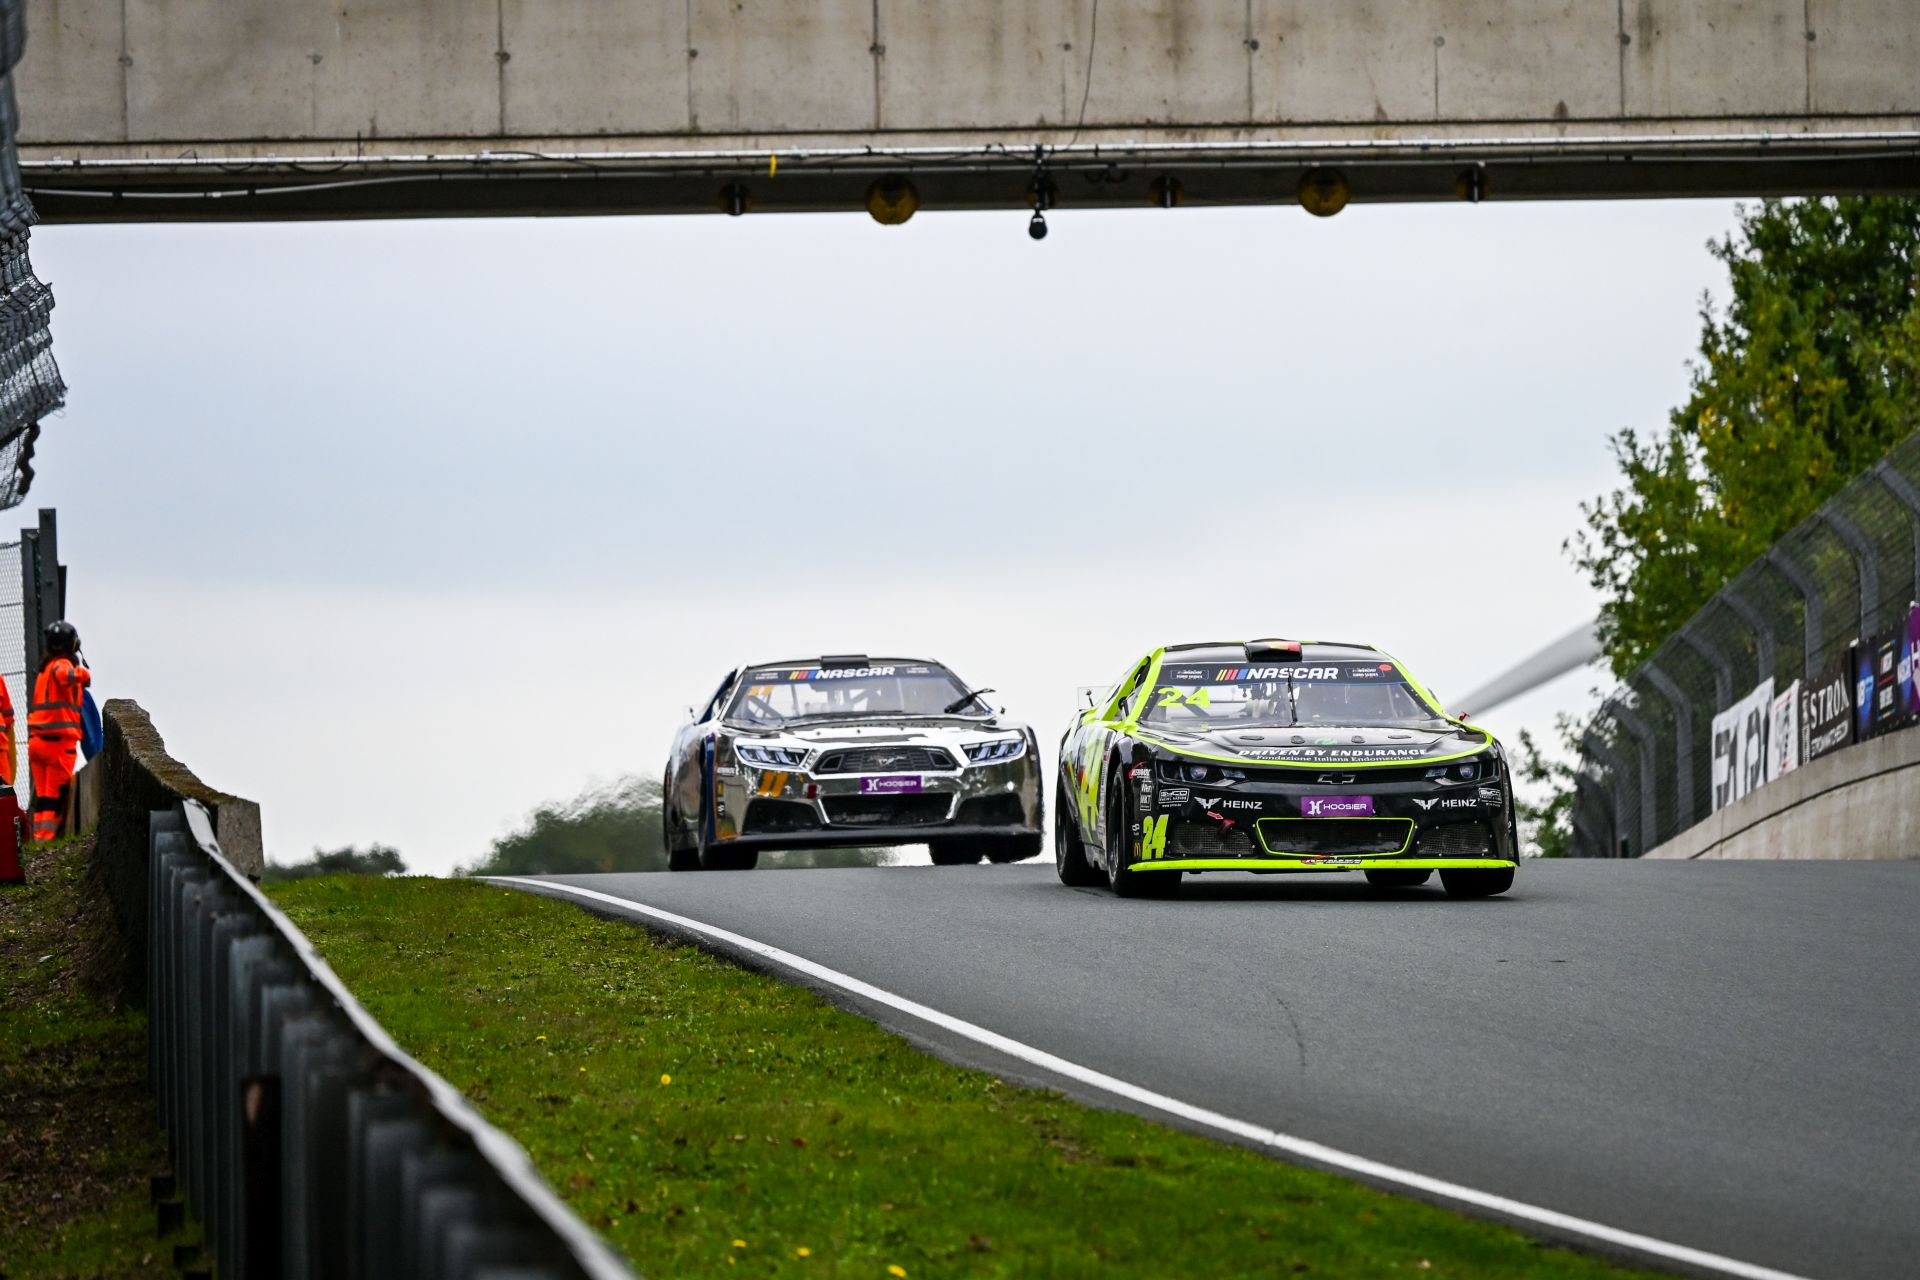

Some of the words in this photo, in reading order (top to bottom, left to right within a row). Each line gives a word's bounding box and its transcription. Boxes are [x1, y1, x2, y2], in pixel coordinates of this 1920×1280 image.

[815, 667, 895, 680] NASCAR
[1246, 667, 1340, 681] NASCAR
[1157, 686, 1211, 709] 24
[1222, 800, 1264, 810] HEINZ
[1322, 802, 1368, 811] HOOSIER
[1440, 799, 1478, 808] HEINZ
[1142, 814, 1169, 860] 24
